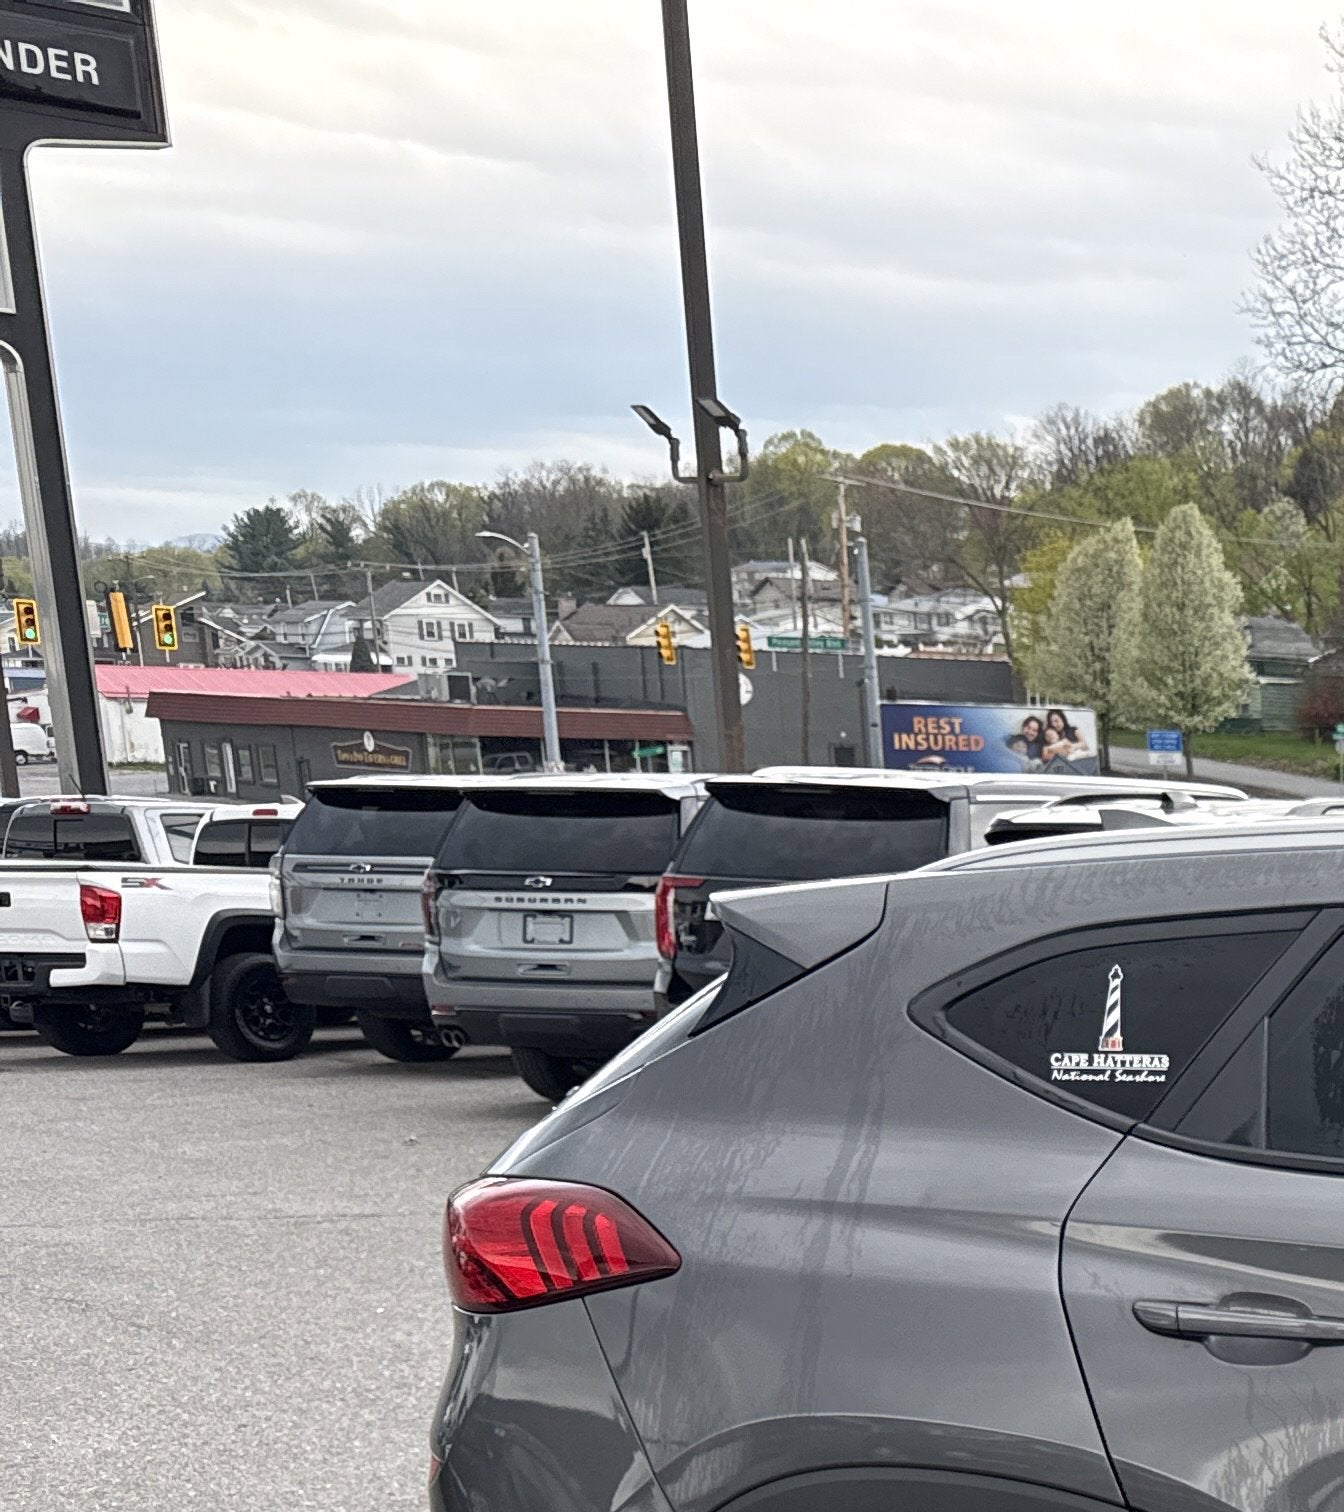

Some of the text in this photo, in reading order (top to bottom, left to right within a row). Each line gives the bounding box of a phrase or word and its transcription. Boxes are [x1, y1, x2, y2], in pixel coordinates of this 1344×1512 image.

[913, 716, 963, 734] REST
[893, 733, 985, 752] INSURED
[494, 896, 587, 904] SUBURBAN
[1050, 1053, 1170, 1068] CAPE HATTERAS
[1051, 1069, 1166, 1082] National Seashore
